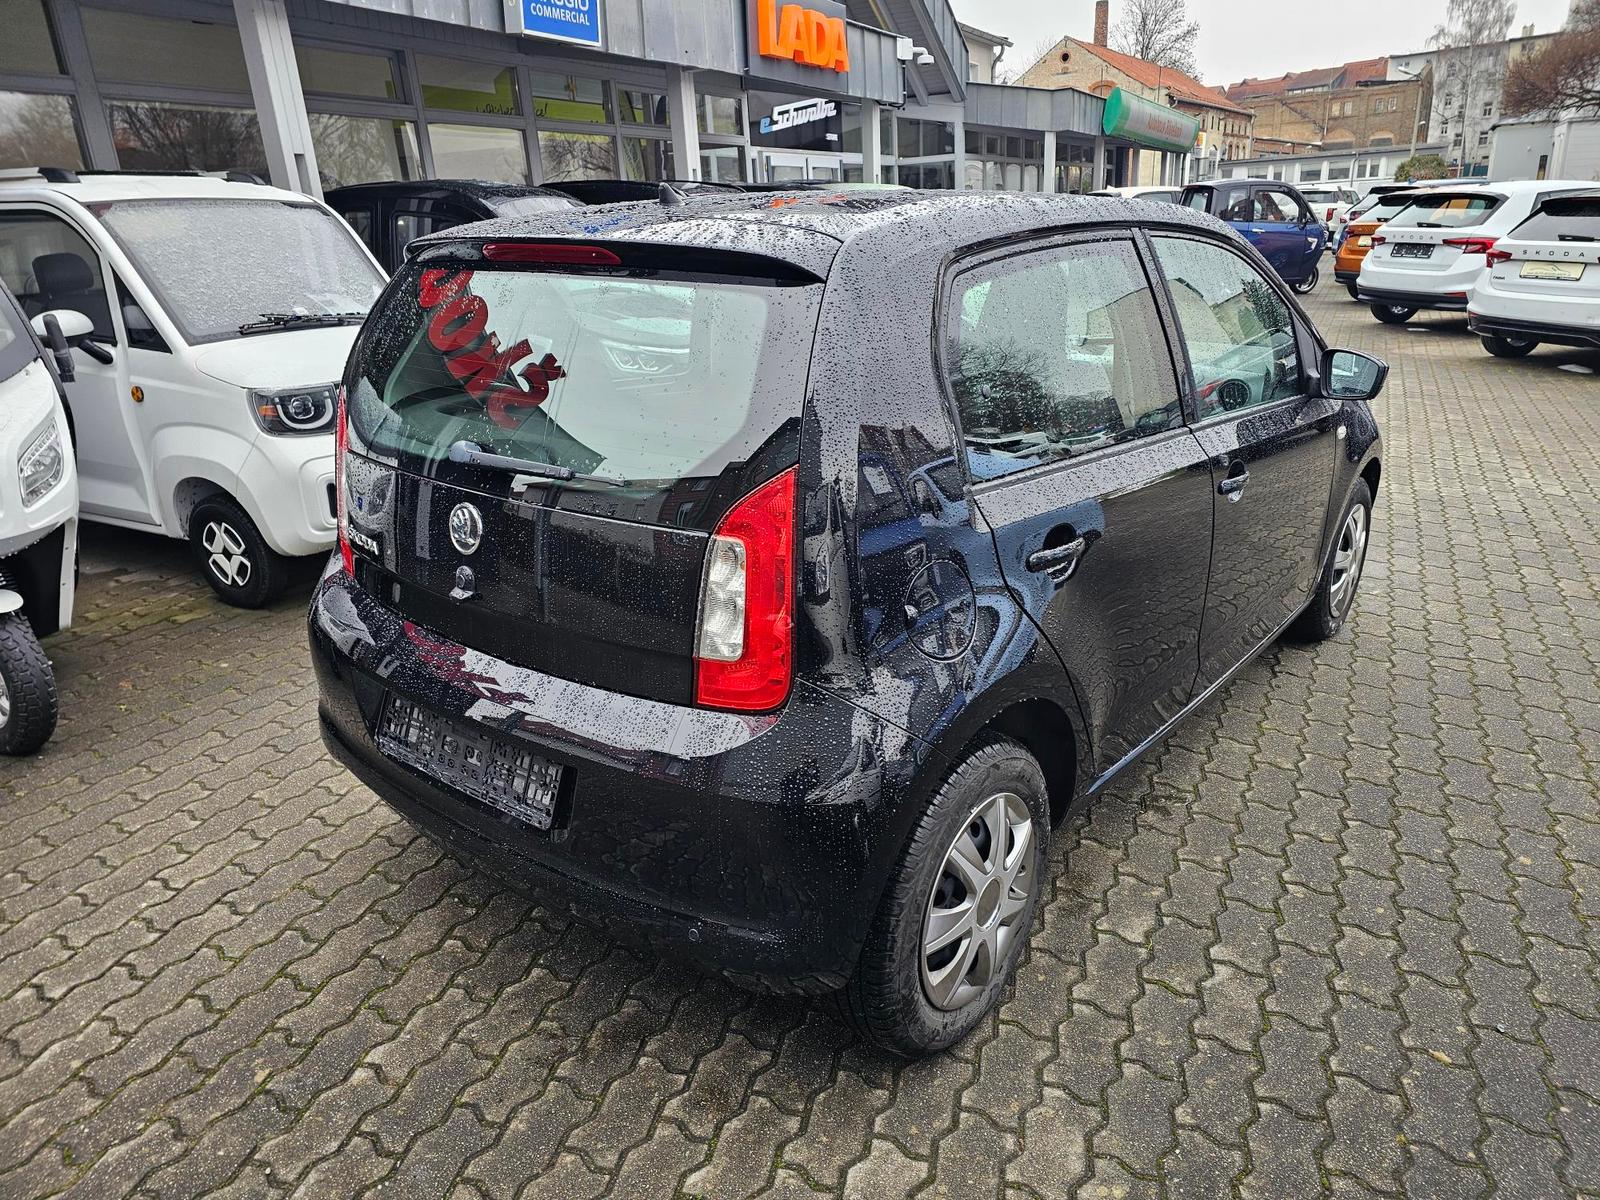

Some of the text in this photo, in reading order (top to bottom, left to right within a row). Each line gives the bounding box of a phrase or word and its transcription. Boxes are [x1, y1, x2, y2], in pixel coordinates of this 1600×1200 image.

[530, 3, 590, 26] COMMERCIAL
[758, 0, 849, 72] LADA
[1522, 249, 1585, 257] SKODA
